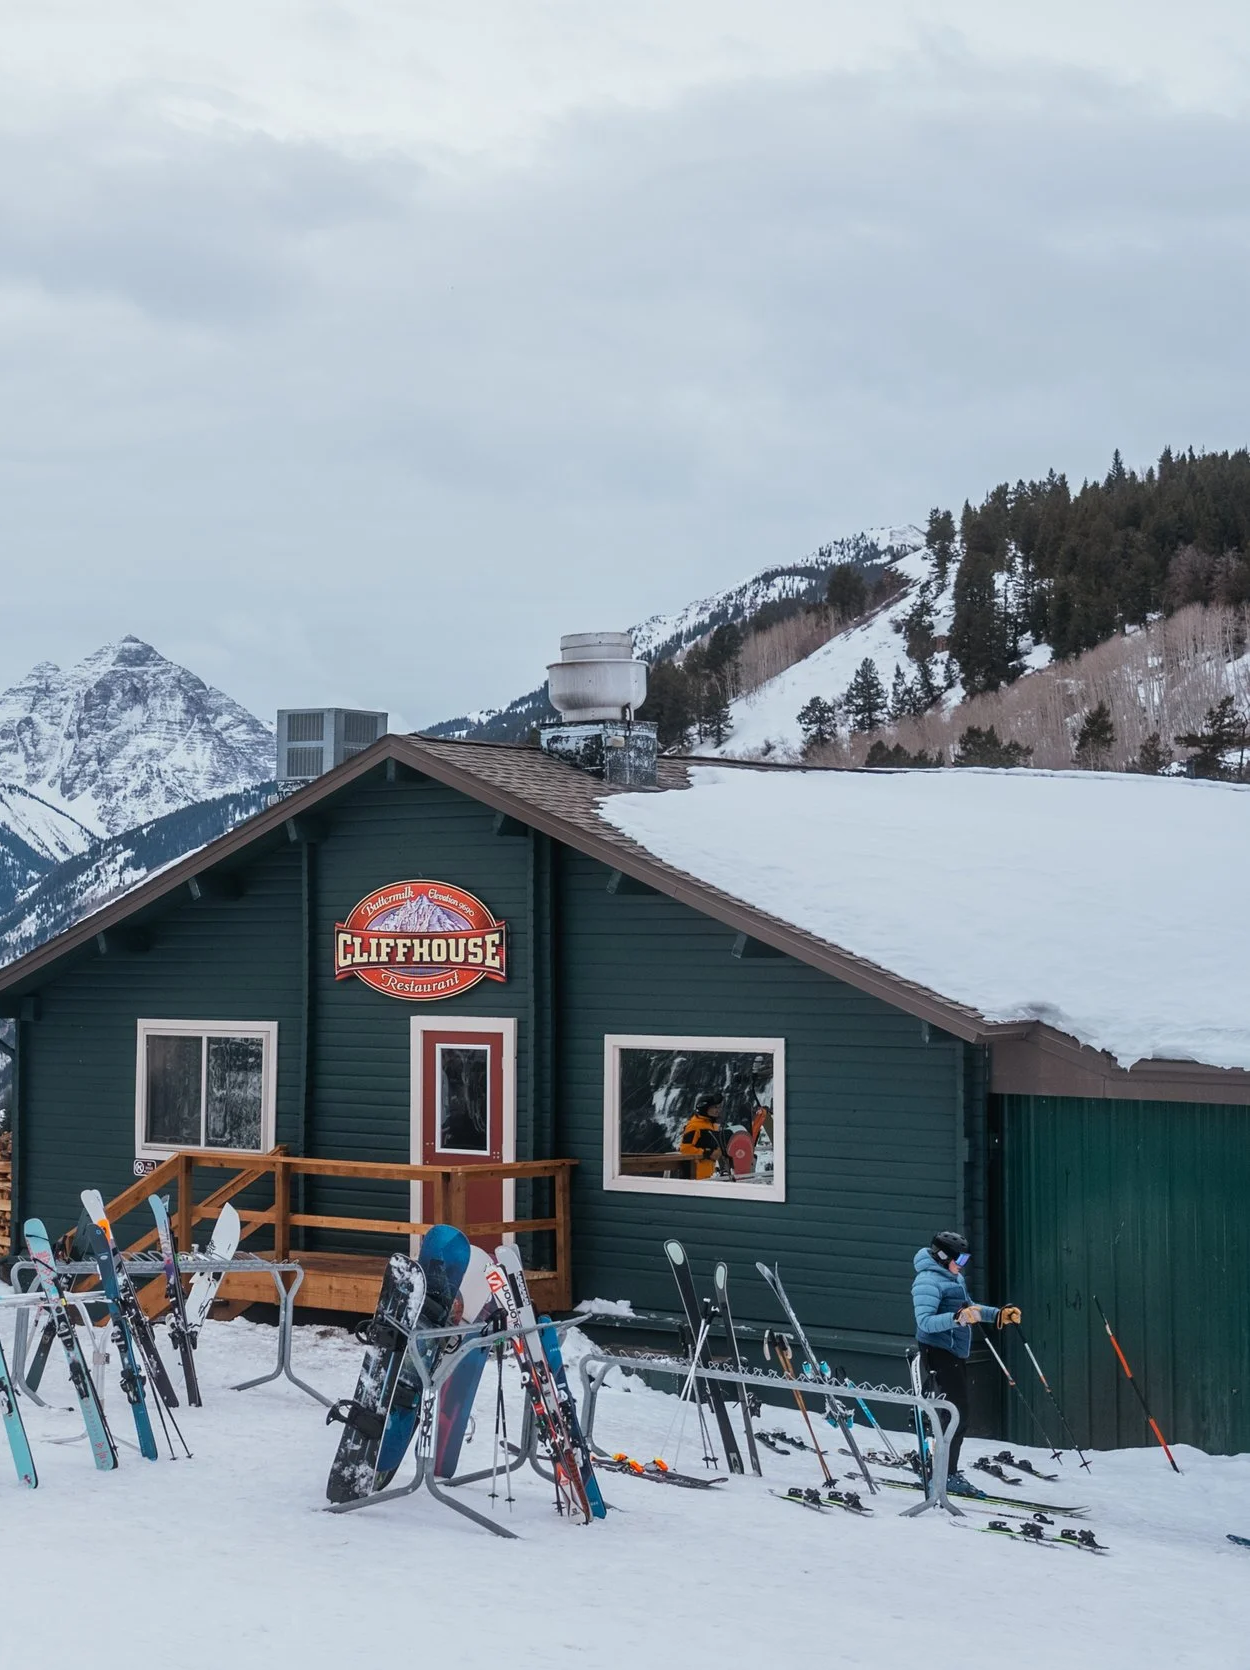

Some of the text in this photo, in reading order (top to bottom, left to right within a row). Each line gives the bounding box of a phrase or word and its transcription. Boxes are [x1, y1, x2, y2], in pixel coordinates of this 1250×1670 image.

[361, 886, 415, 917] Buttermilk
[428, 889, 459, 906] Elevation
[338, 933, 500, 968] CLIFFHOUSE
[381, 971, 460, 993] Restaurant
